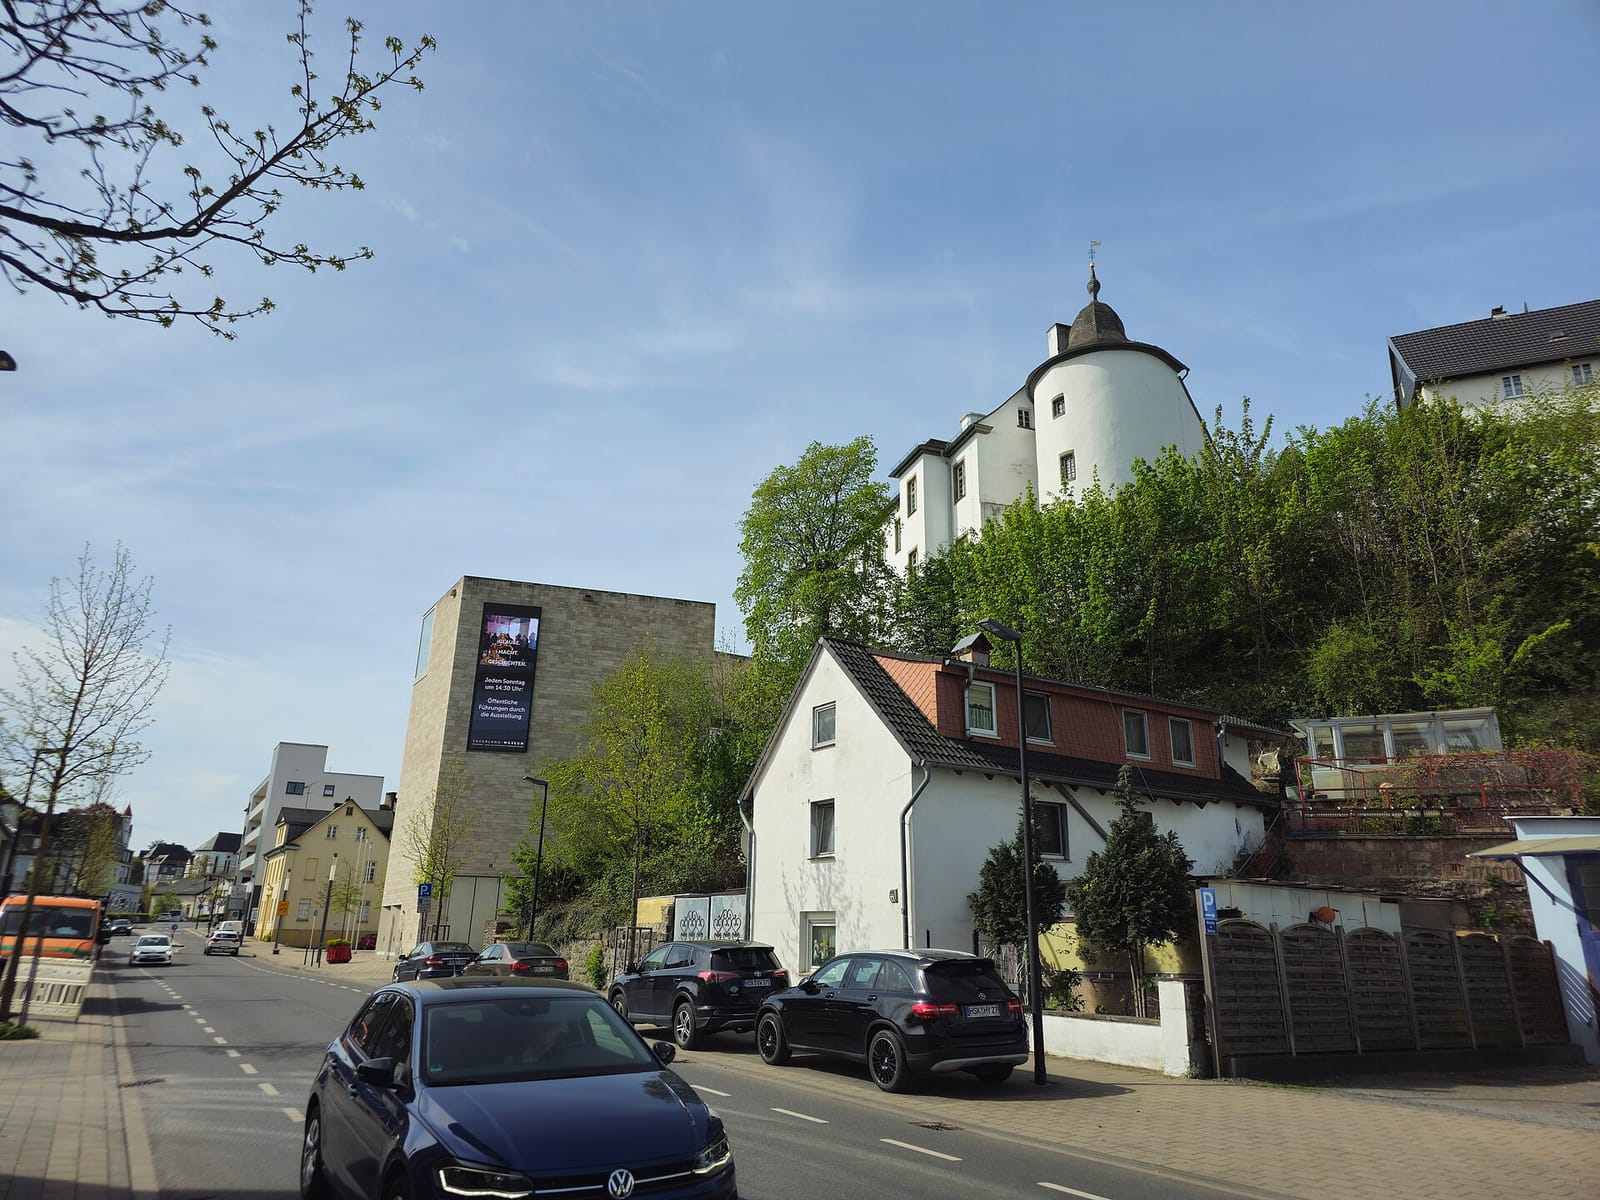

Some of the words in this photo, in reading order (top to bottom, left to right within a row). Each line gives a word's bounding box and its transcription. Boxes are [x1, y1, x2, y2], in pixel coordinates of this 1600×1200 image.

[503, 678, 526, 686] Sonntag
[487, 697, 519, 705] Öffentliche
[478, 704, 509, 712] Führungen
[490, 712, 522, 720] Ausstellung
[420, 885, 429, 896] P
[1202, 891, 1214, 912] P
